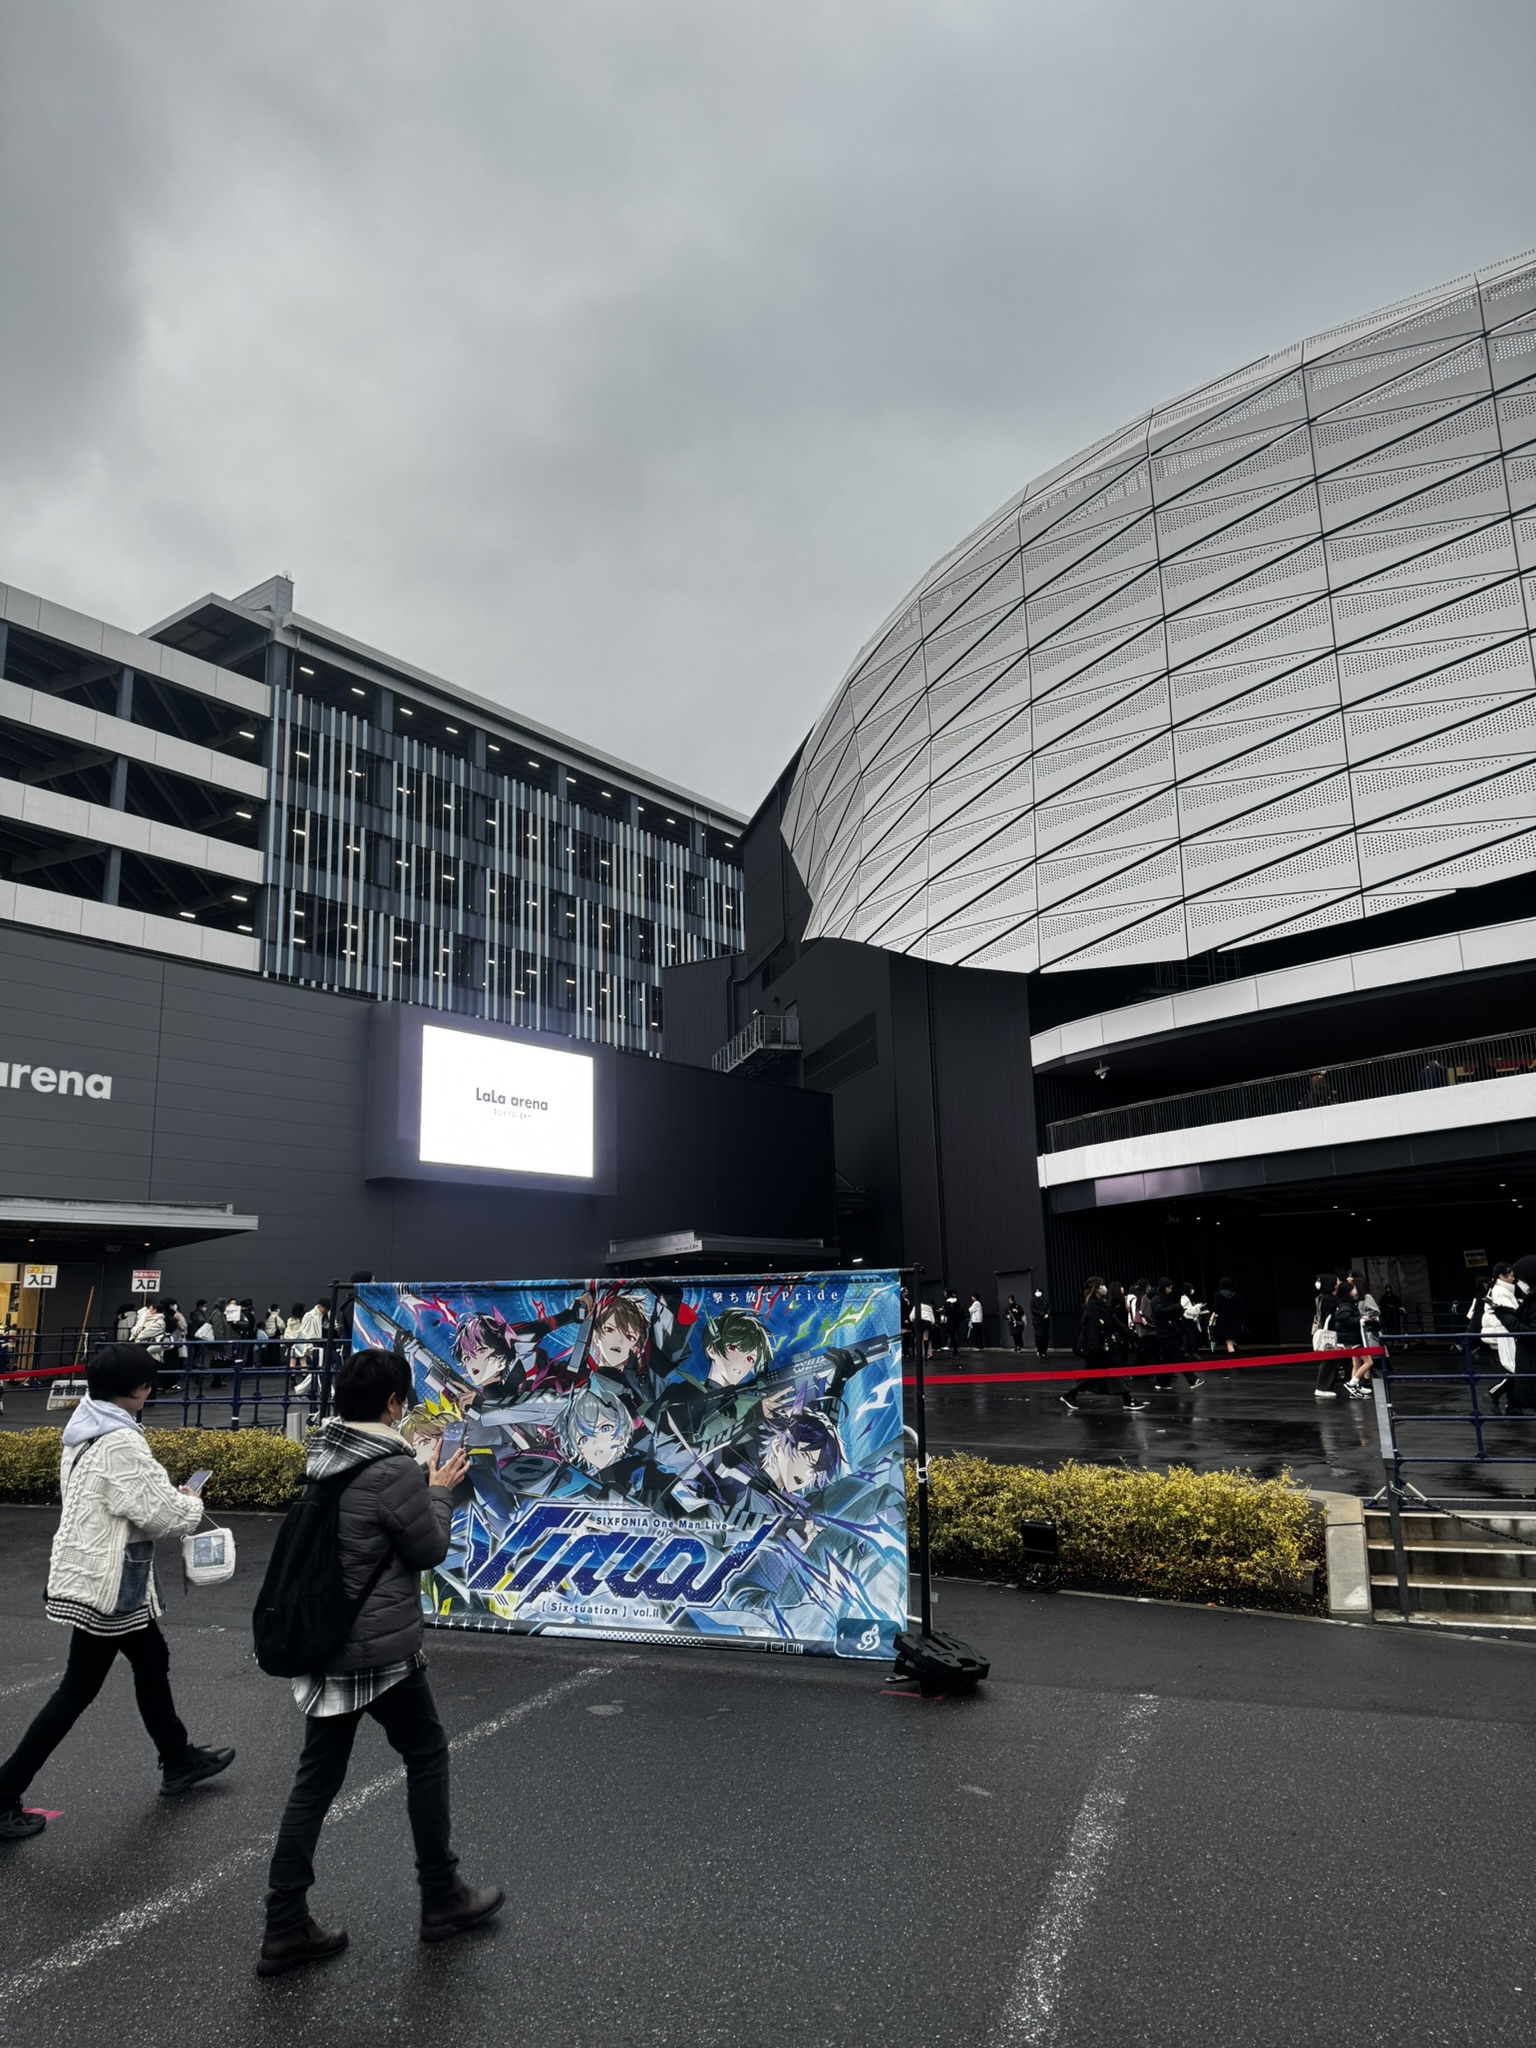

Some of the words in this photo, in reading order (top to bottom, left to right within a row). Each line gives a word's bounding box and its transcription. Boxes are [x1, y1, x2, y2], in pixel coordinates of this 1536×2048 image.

[476, 1087, 506, 1105] LaLa
[511, 1096, 548, 1111] arena
[28, 1275, 52, 1286] 入口
[136, 1279, 157, 1290] 入口
[713, 1291, 772, 1304] 撃ち放て
[782, 1290, 838, 1301] Pride
[596, 1517, 649, 1527] SIXFONIA
[653, 1520, 674, 1528] One
[679, 1520, 701, 1529] Man
[705, 1521, 728, 1530] Live
